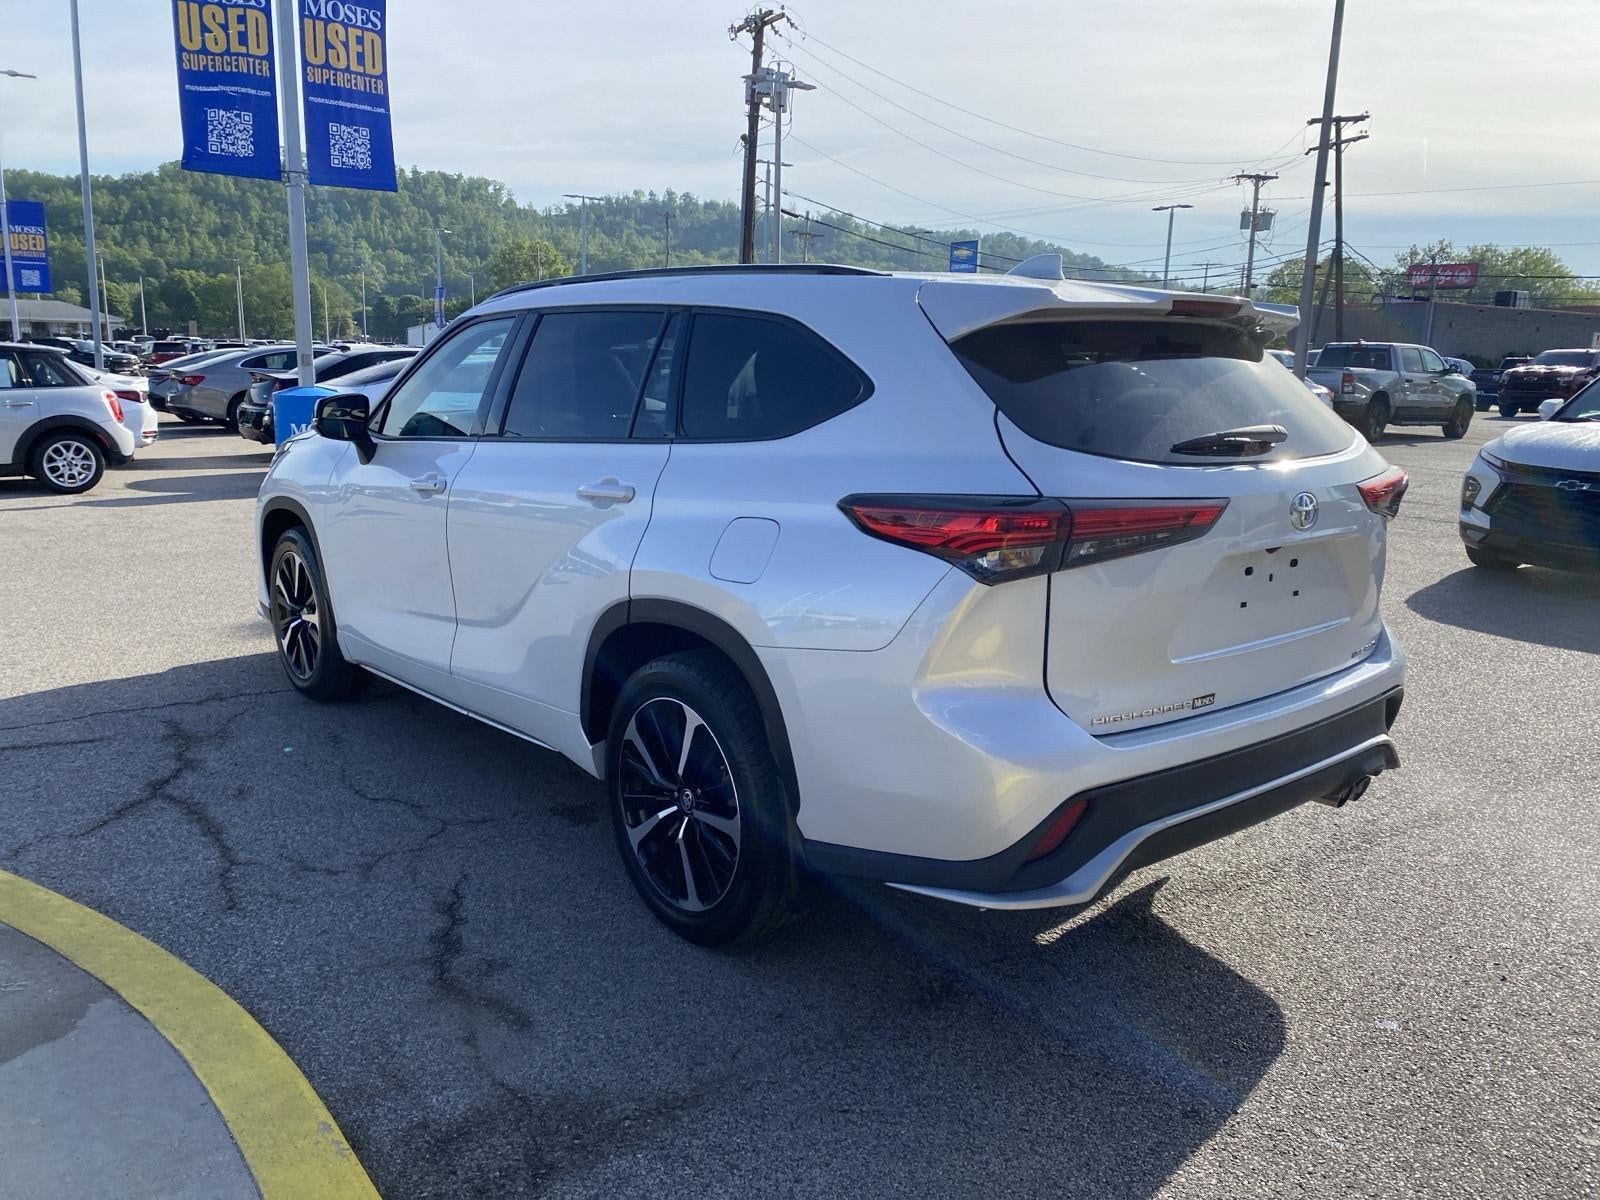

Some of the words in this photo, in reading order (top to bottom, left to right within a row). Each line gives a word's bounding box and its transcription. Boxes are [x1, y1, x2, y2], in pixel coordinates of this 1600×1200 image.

[177, 1, 269, 56] USED
[304, 0, 382, 31] MOSES
[303, 17, 384, 76] USED
[182, 52, 270, 77] SUPERCENTER
[307, 66, 384, 95] SUPERCENTER
[9, 224, 44, 234] MOSES
[9, 233, 46, 252] USED
[1090, 700, 1192, 726] HIGHLANDER
